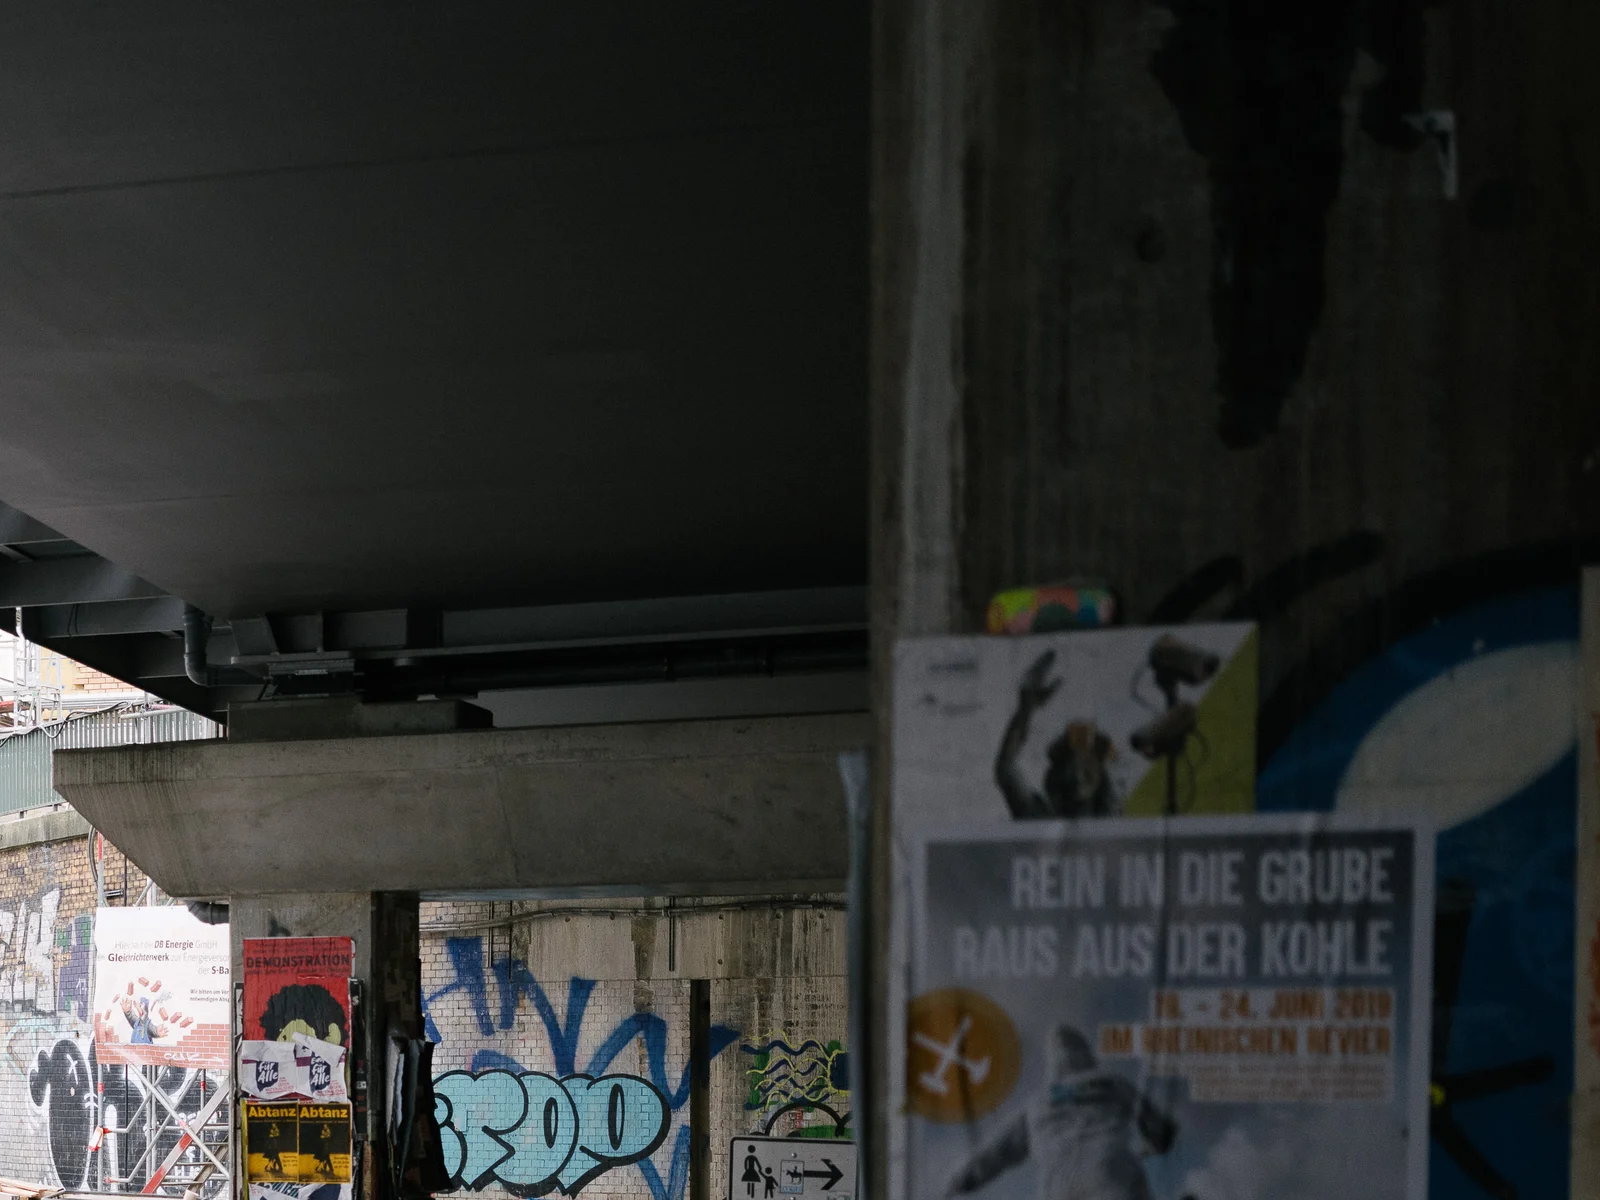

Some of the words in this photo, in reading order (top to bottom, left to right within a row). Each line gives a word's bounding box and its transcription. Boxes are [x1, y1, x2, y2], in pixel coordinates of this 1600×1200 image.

[1011, 854, 1106, 909] REIN
[1119, 852, 1164, 908] IN
[1182, 850, 1243, 906] DIE
[1257, 847, 1396, 904] GRUBE
[154, 940, 164, 949] DB
[165, 940, 194, 950] Energie
[954, 924, 1057, 980] RAUS
[1073, 923, 1156, 979] AUS
[1167, 921, 1247, 977] DER
[1262, 919, 1394, 977] KOHLE
[108, 952, 170, 962] Gleichrichterwerk
[246, 954, 350, 968] DEMONSTRATION
[248, 1106, 296, 1118] Abtanz
[300, 1106, 348, 1118] Abtanz
